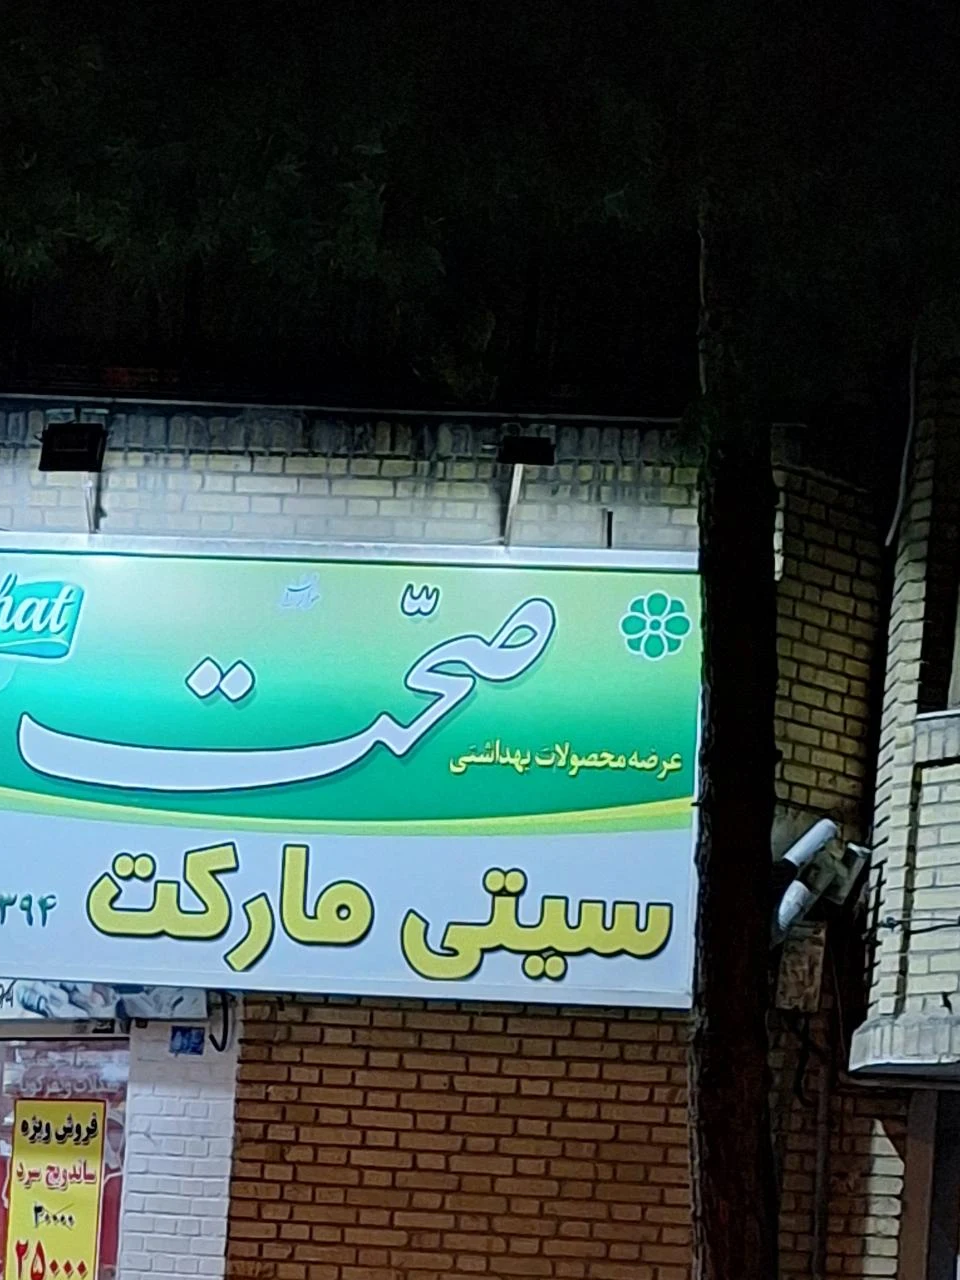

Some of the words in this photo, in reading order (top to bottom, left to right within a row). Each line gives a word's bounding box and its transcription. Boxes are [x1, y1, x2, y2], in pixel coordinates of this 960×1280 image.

[449, 739, 532, 774] بهداشتی
[535, 741, 627, 776] محصولات
[628, 748, 683, 779] عرضه
[86, 842, 376, 973] مارکت
[401, 868, 675, 981] سیتی
[20, 1113, 51, 1144] ویژه
[54, 1113, 99, 1145] فروش
[16, 1161, 41, 1188] سرد
[45, 1159, 97, 1190] ساندویچ
